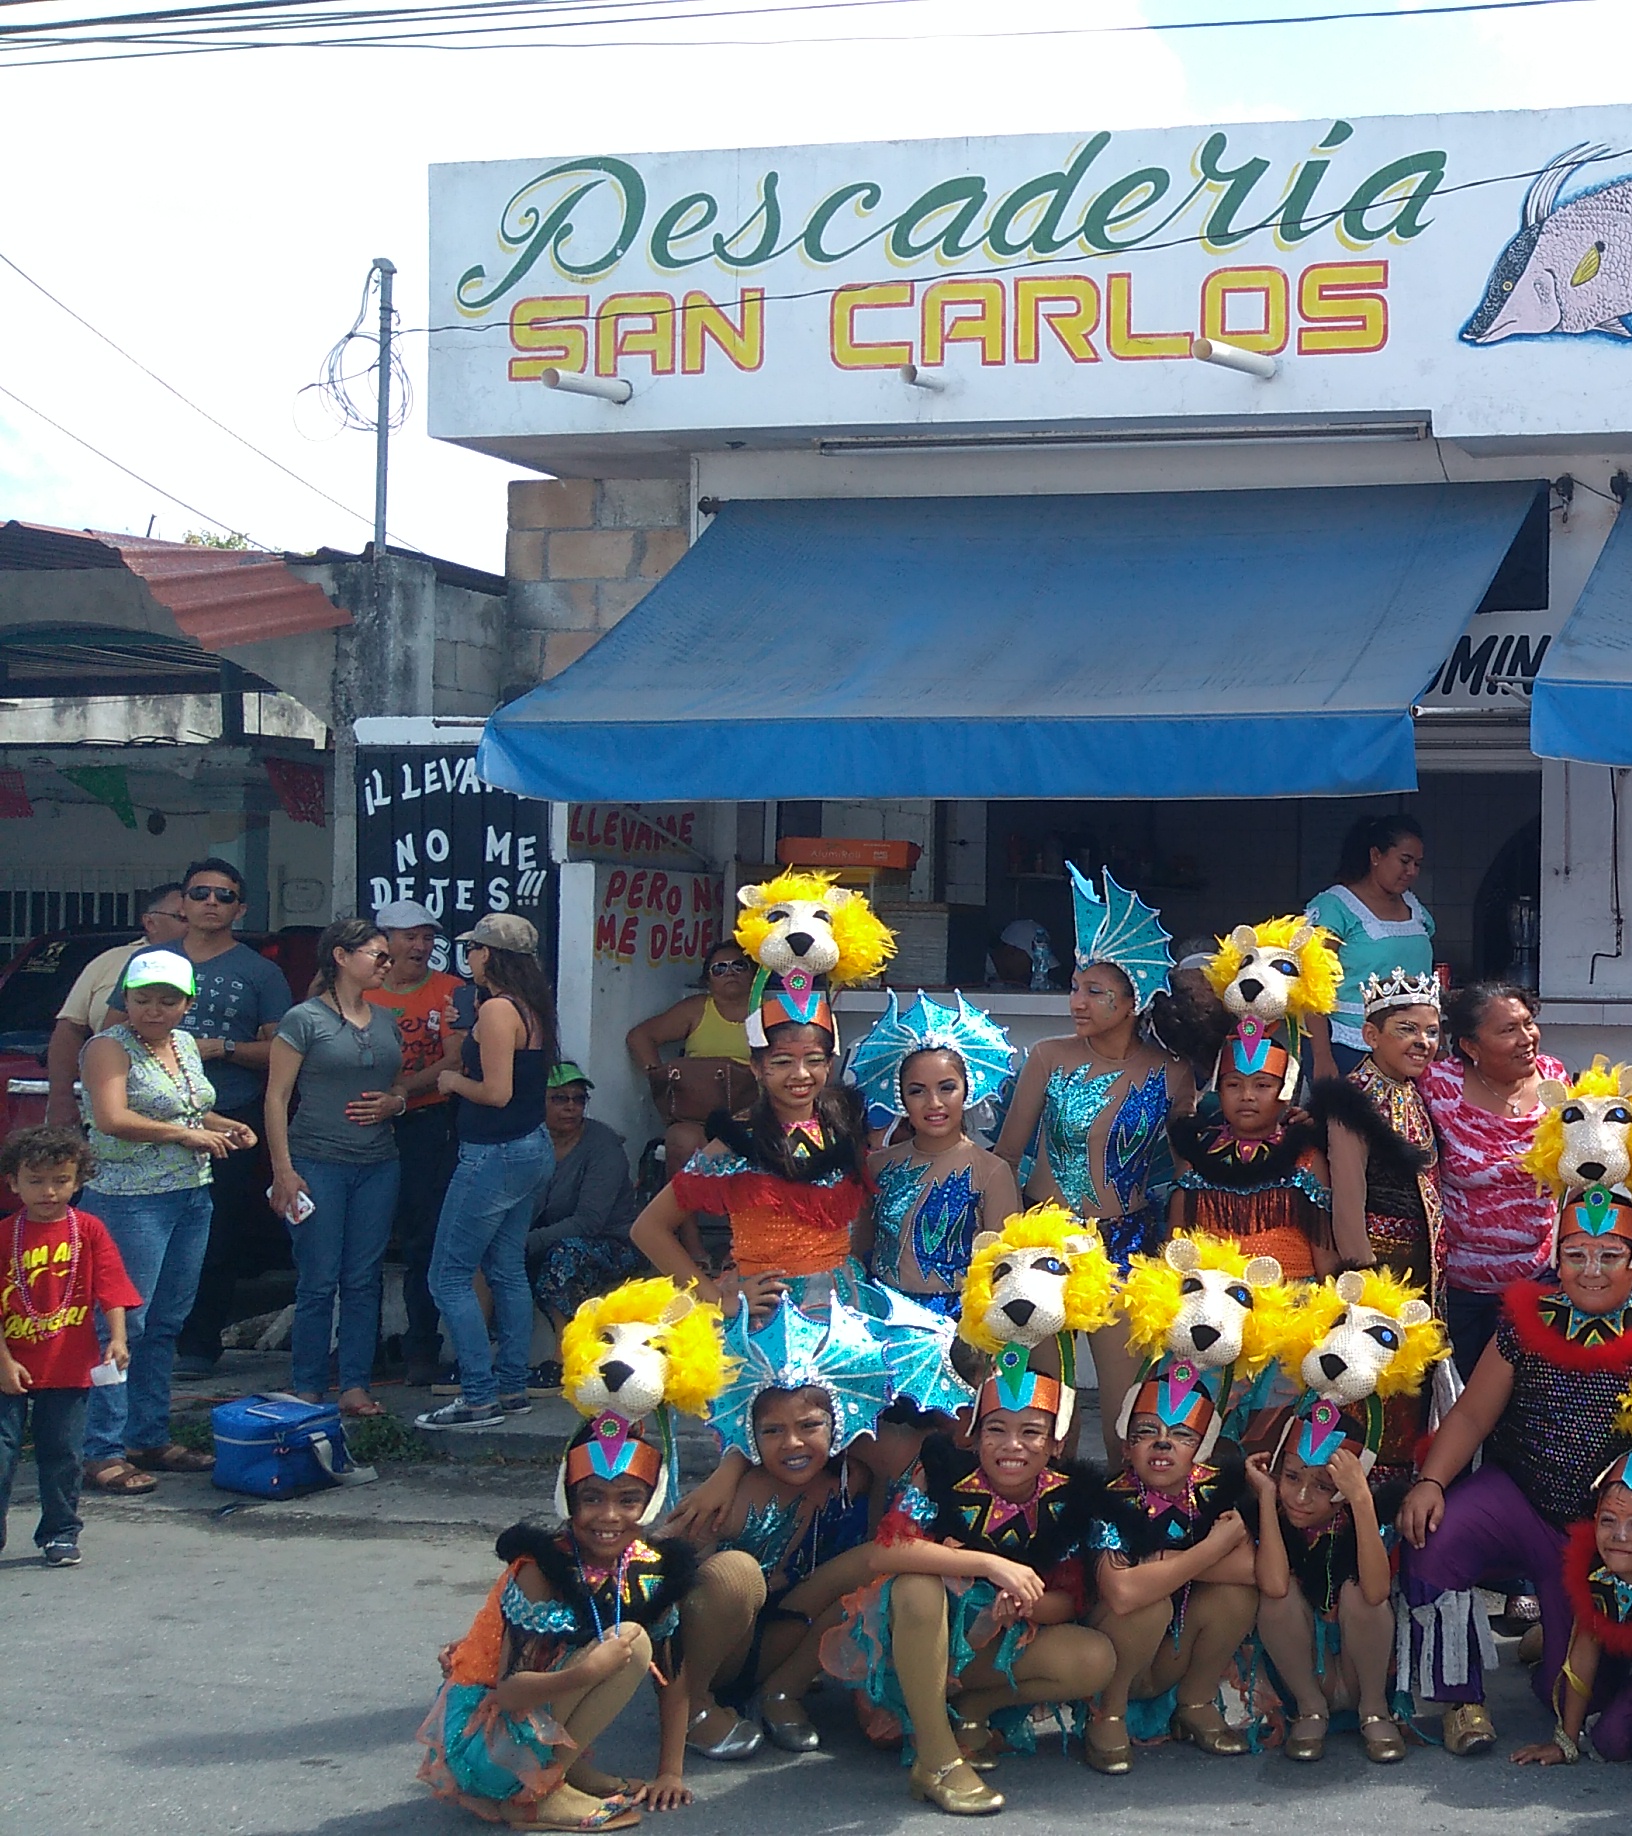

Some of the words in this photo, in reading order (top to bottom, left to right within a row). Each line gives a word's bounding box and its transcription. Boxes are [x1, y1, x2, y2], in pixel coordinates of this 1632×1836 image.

[456, 119, 1449, 318] Pescadería
[508, 286, 766, 382] SAN
[829, 259, 1390, 369] CARLOS
[1425, 634, 1552, 696] MIN
[396, 829, 450, 873] NO
[485, 825, 537, 871] ME
[604, 870, 683, 917] PERO
[595, 913, 640, 956] ME
[650, 917, 724, 960] DEJE
